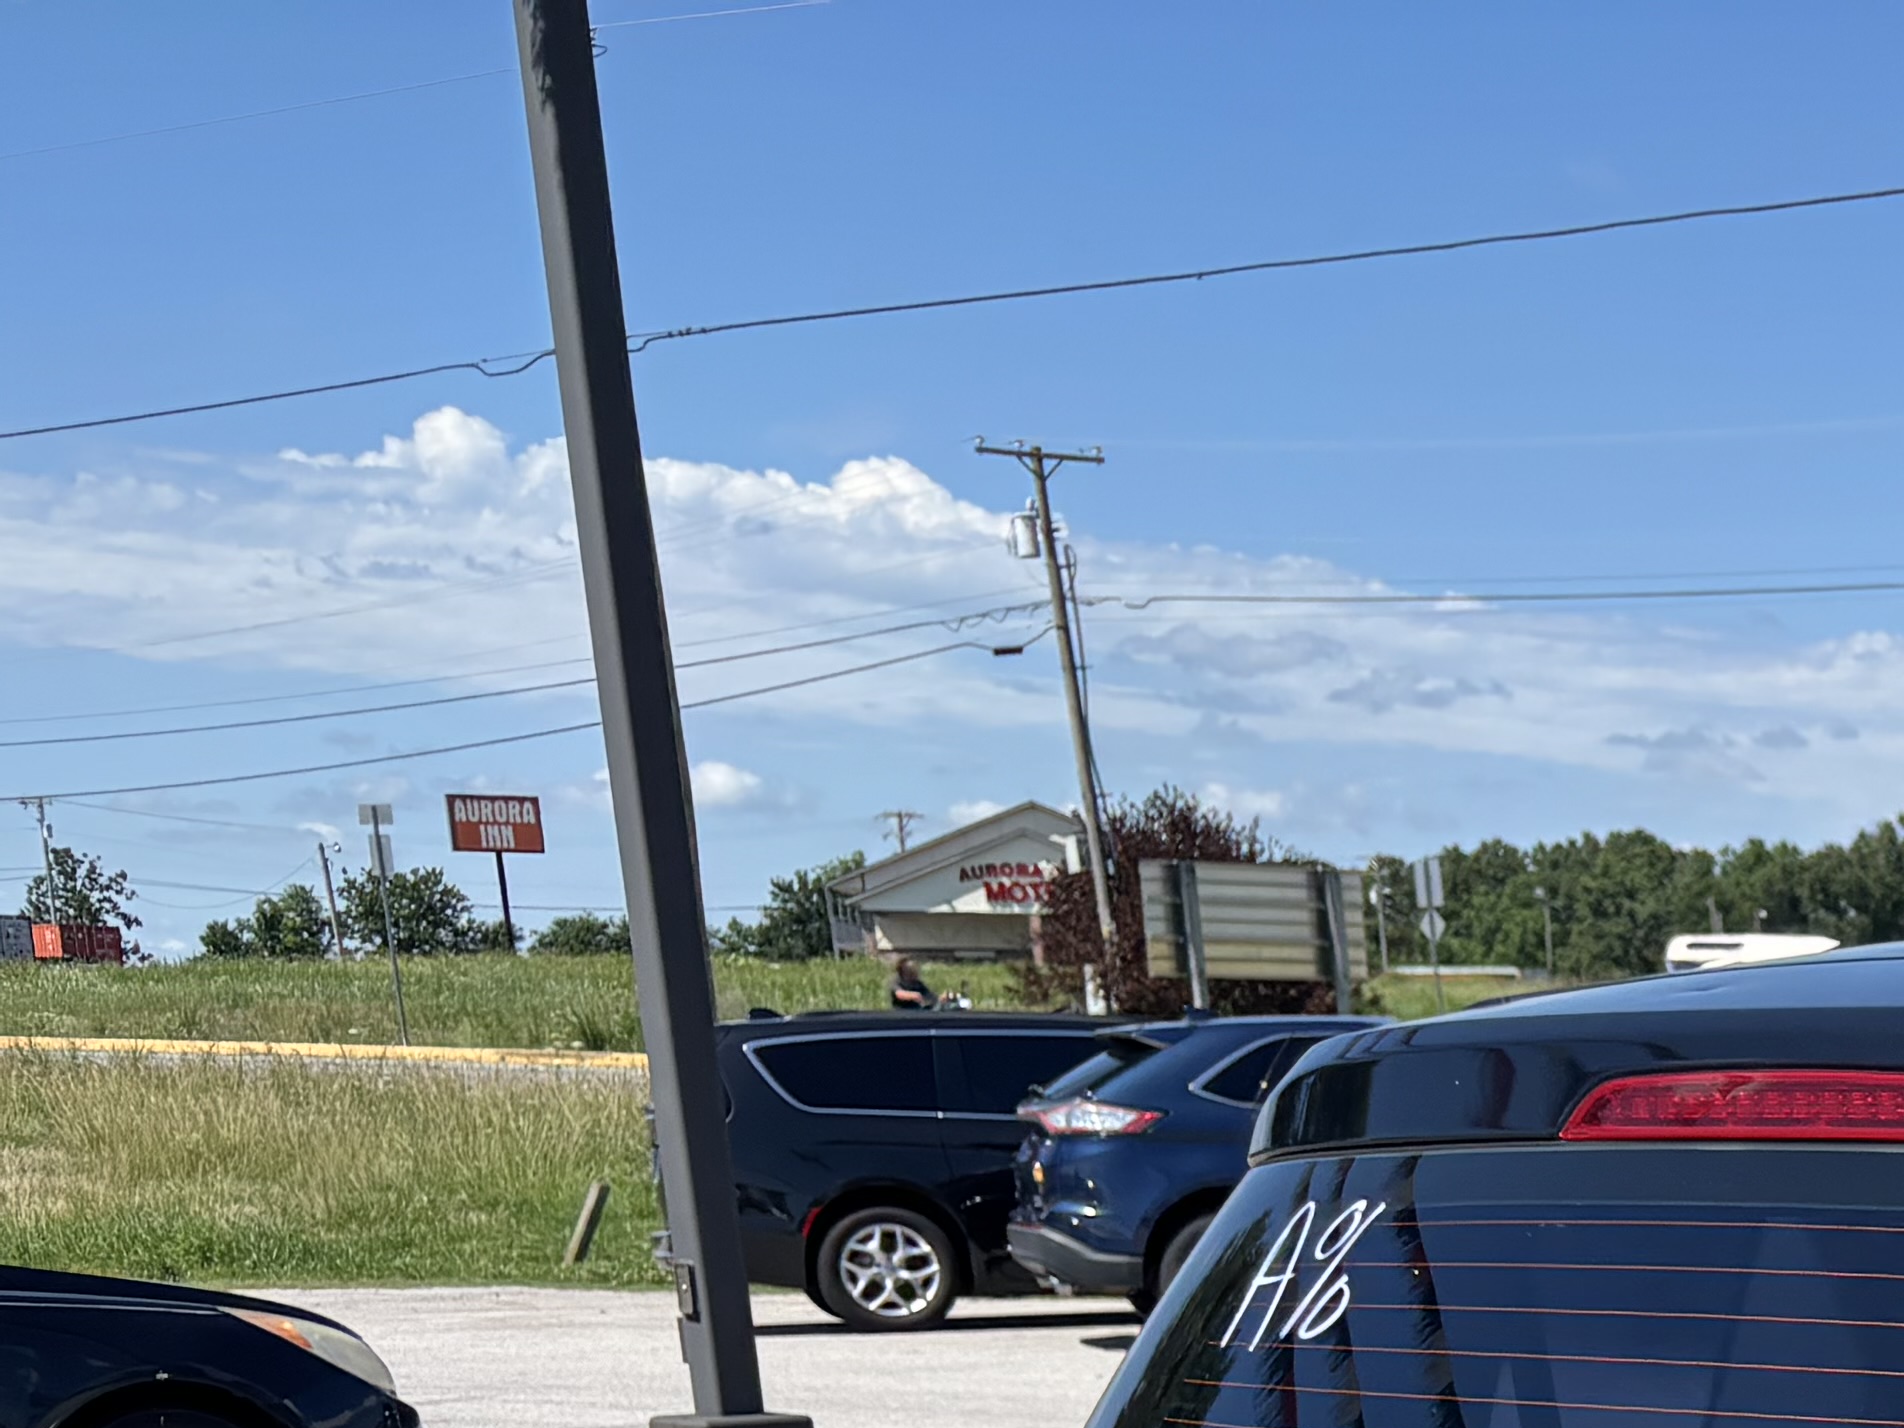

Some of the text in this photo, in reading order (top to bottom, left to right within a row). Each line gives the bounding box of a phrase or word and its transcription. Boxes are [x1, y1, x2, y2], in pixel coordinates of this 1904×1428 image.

[454, 798, 536, 824] AURORA
[480, 824, 515, 849] INN
[959, 862, 1043, 882] AURORA
